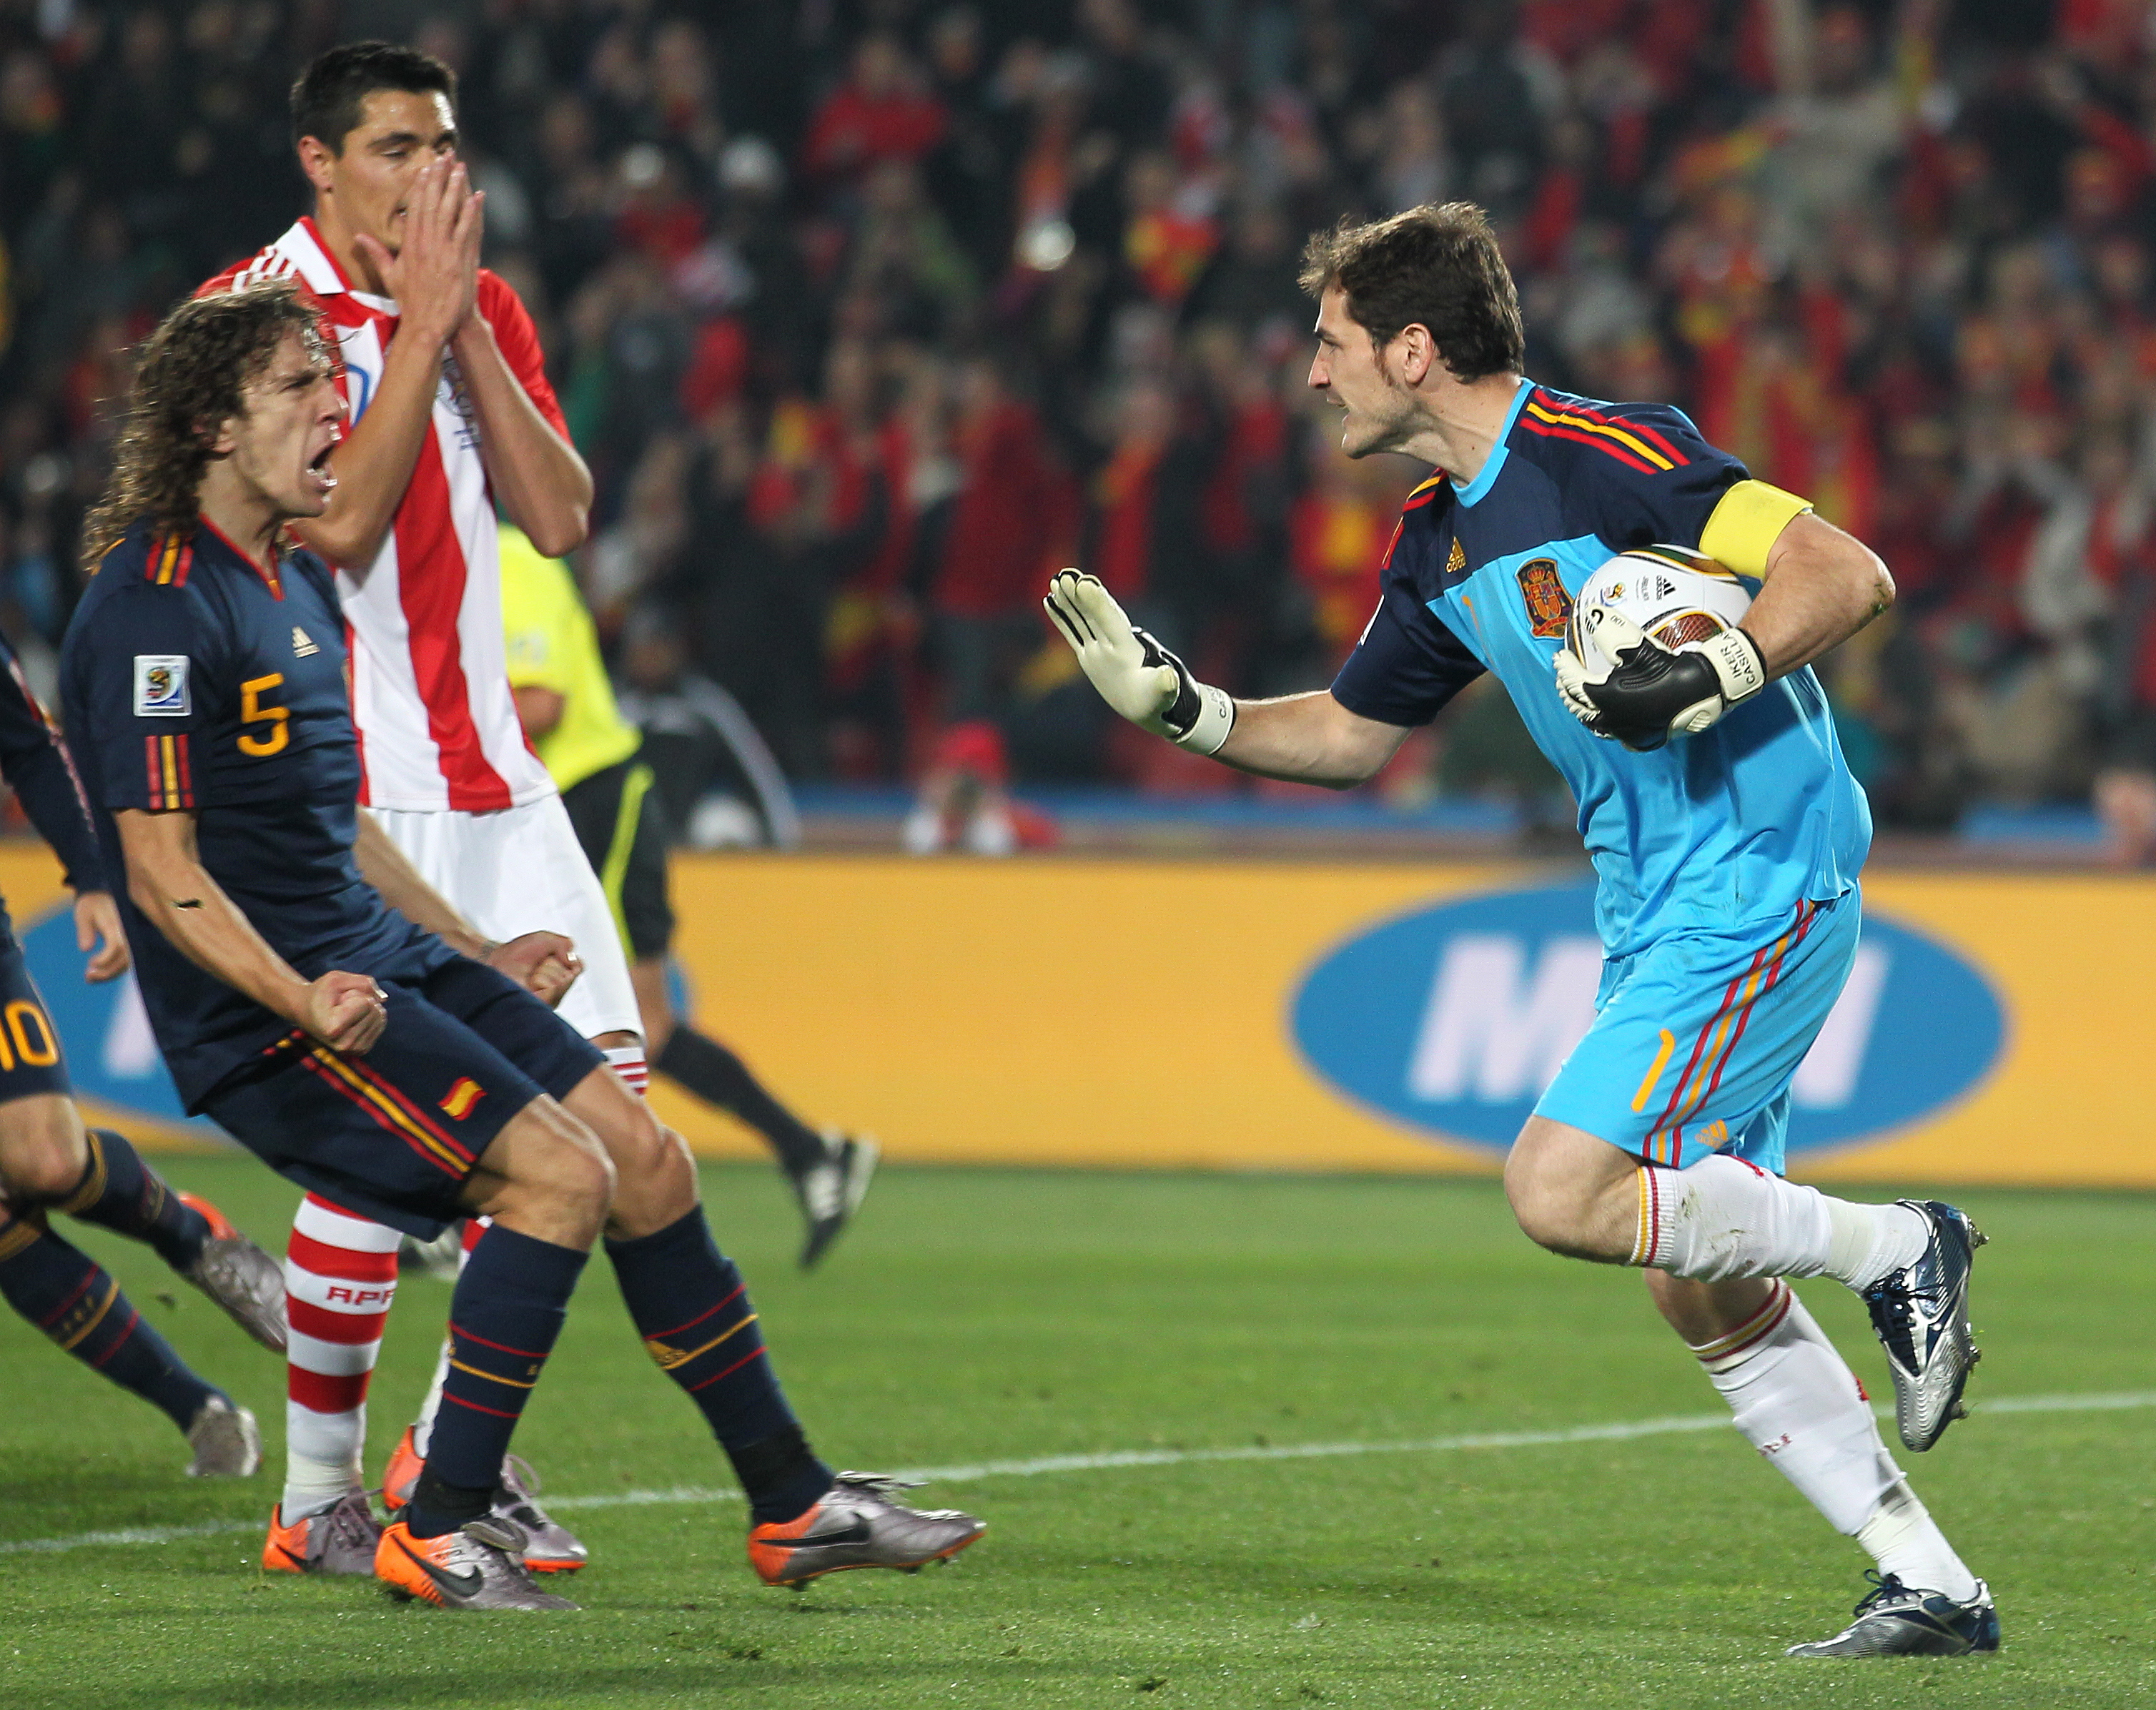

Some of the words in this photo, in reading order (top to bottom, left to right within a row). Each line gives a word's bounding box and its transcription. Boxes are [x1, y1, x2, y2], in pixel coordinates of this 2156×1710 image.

[1720, 646, 1739, 679] IKER
[237, 672, 291, 757] 5
[0, 998, 59, 1071] 10
[1410, 936, 1889, 1108] MN
[1631, 1028, 1676, 1113] 1
